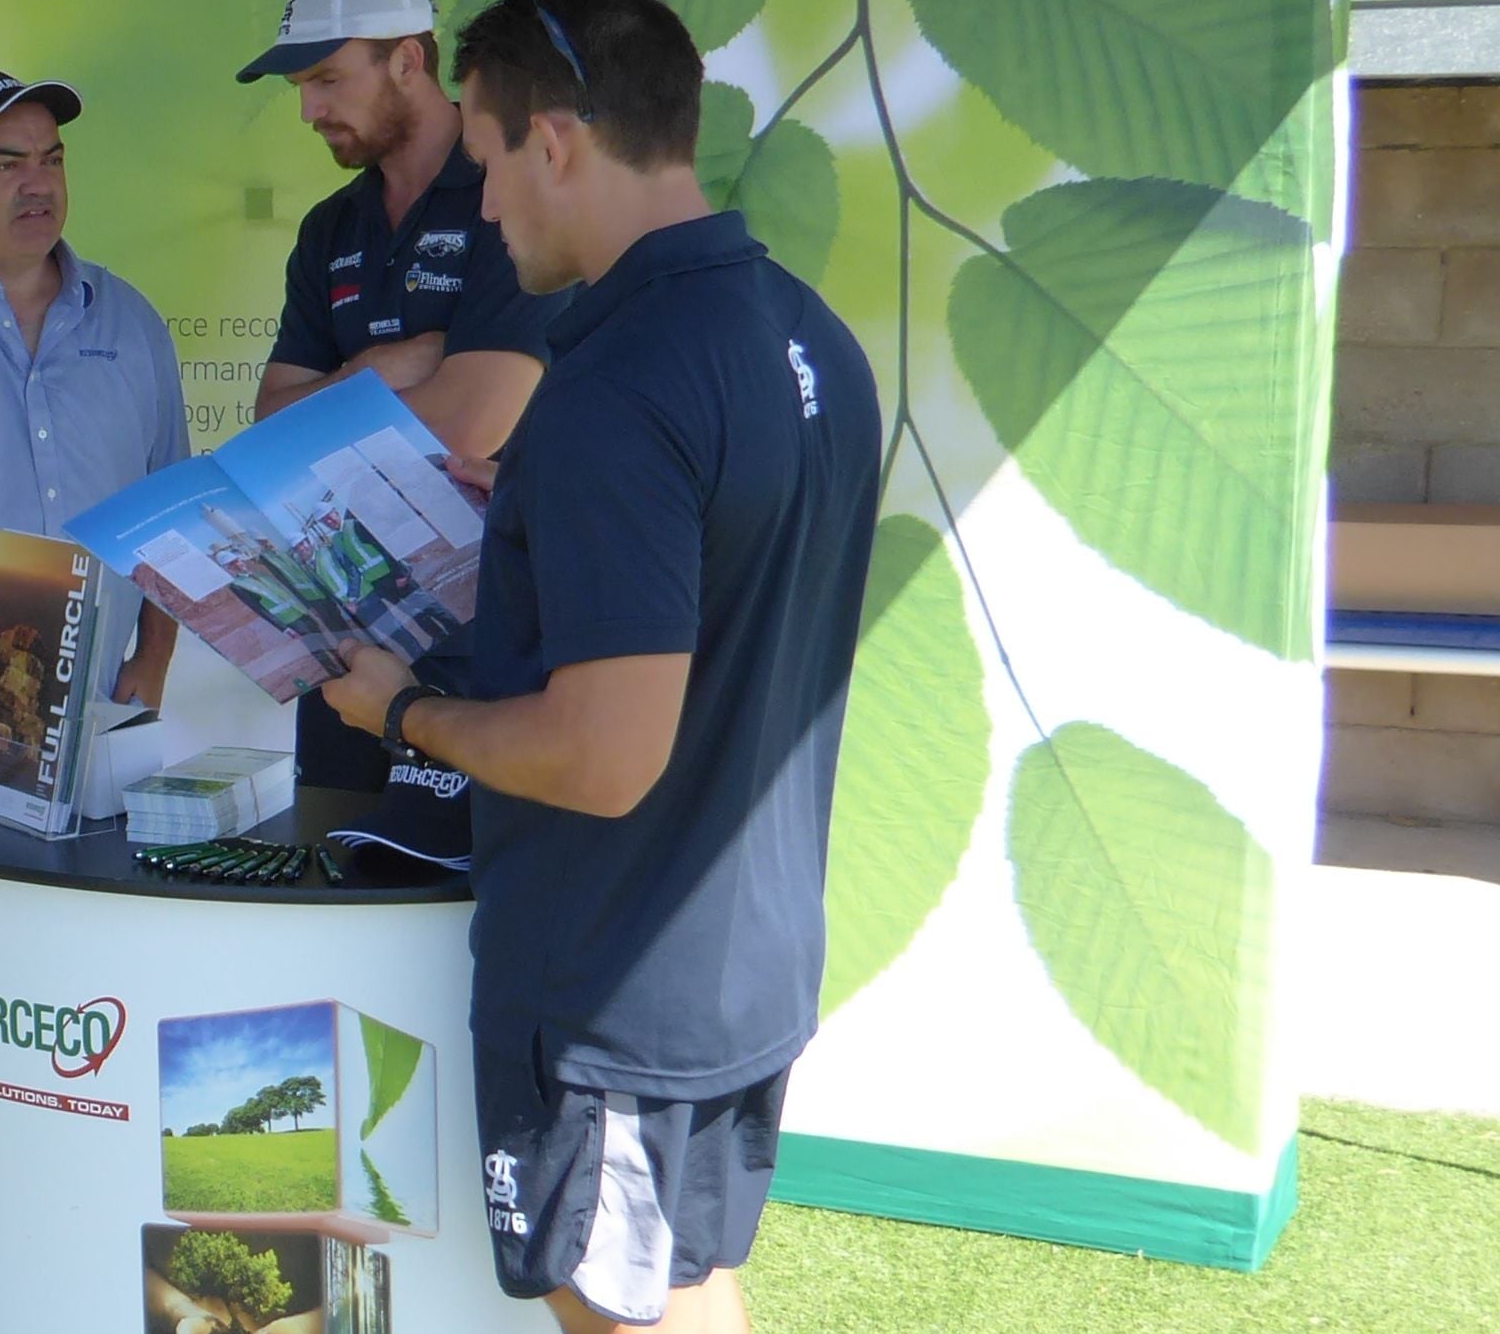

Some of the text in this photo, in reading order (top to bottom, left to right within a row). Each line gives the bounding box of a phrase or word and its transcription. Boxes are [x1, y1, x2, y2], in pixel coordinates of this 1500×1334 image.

[39, 553, 90, 785] FULL CIRCLE
[67, 1099, 125, 1118] TODAY
[489, 1207, 528, 1234] 1876
